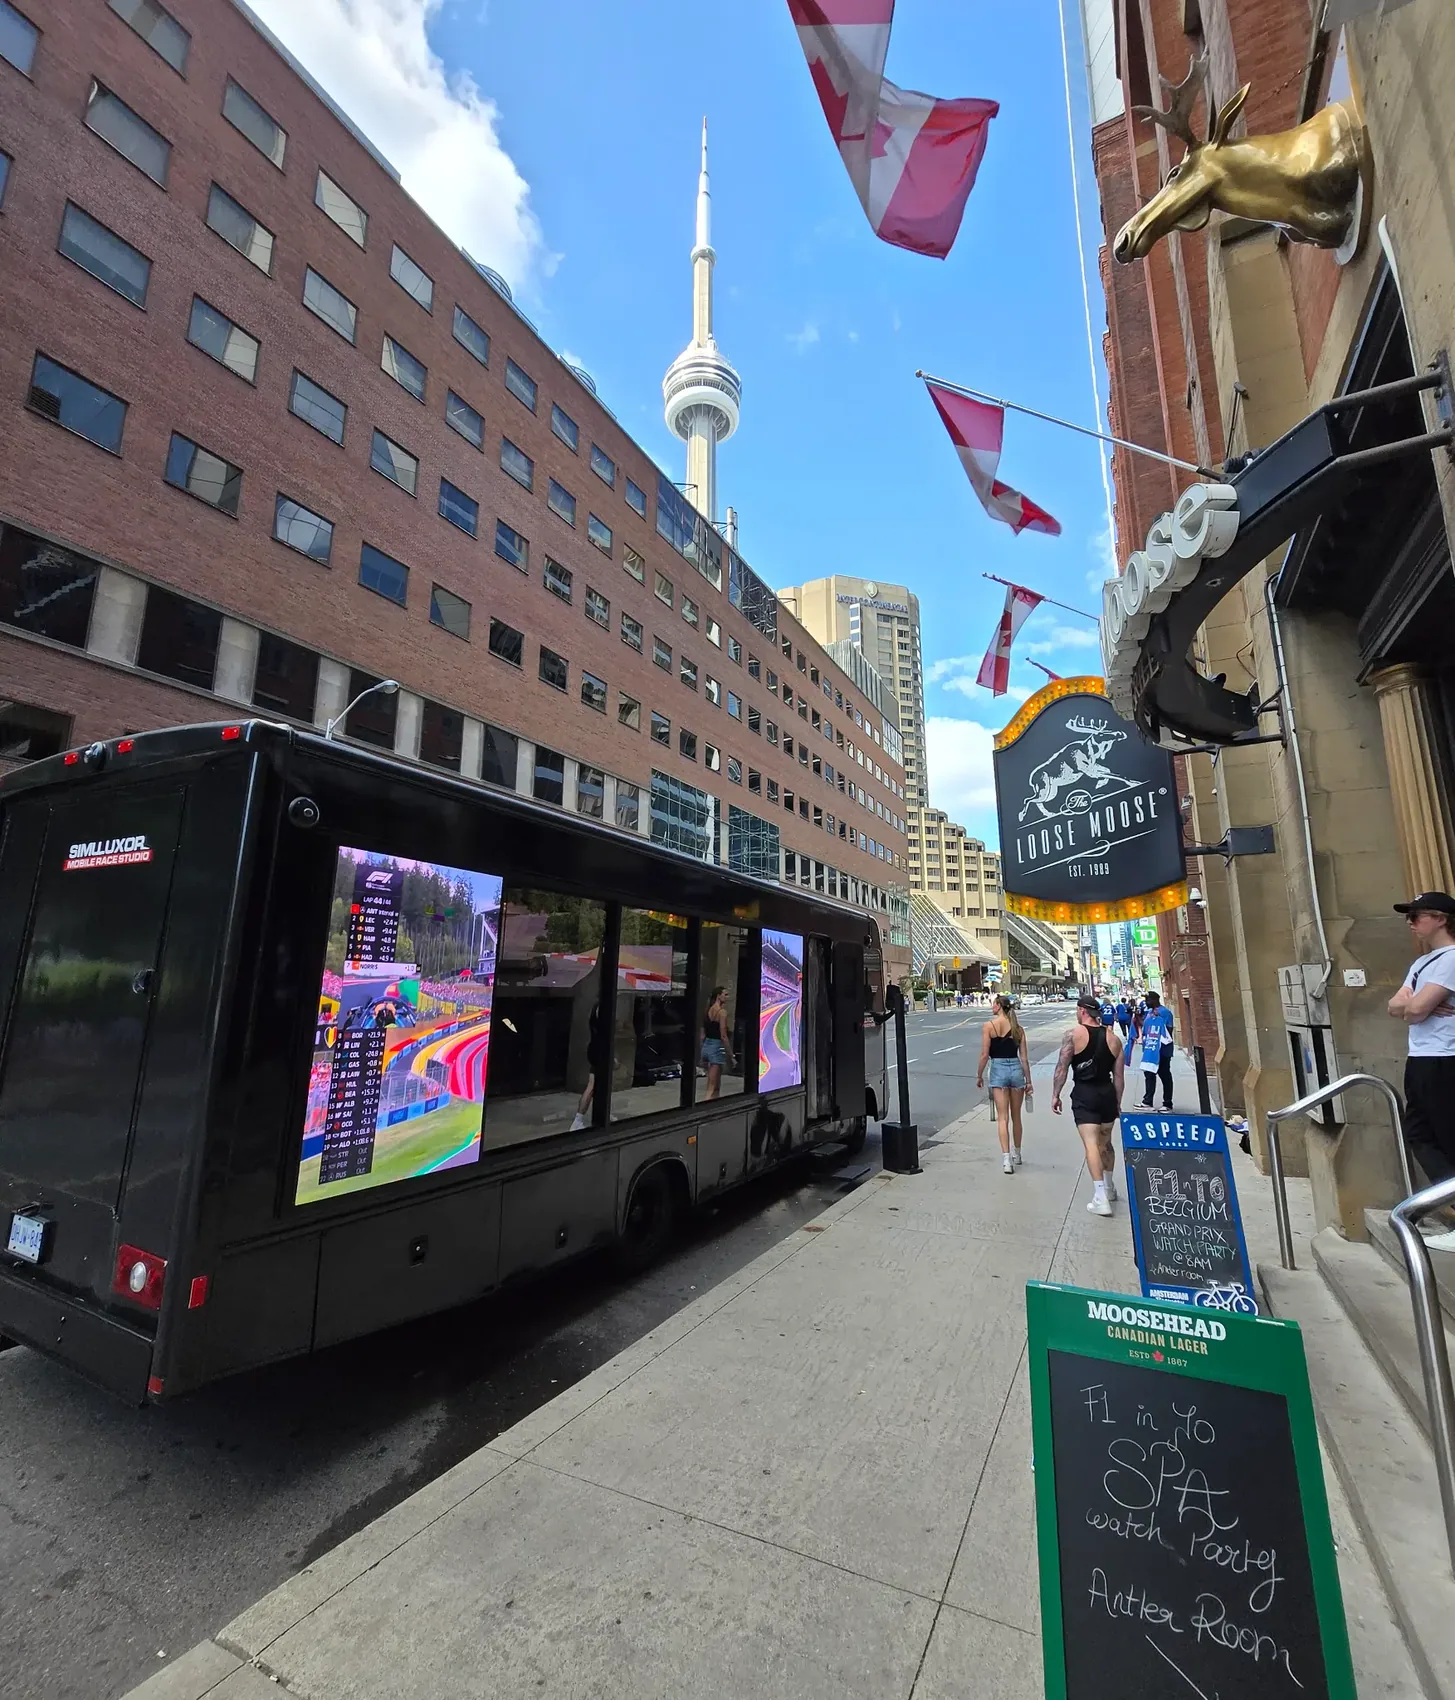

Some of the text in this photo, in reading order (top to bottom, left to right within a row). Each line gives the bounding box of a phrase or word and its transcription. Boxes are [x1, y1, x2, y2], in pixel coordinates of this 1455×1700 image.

[1068, 793, 1088, 809] The
[1016, 819, 1076, 864] LOOSE
[66, 851, 150, 869] MOBILE RACE STUDIO
[1068, 862, 1110, 878] EST. 1989
[1136, 929, 1156, 941] TD
[340, 1130, 352, 1138] BOT
[338, 1140, 351, 1149] ALO
[337, 1151, 349, 1159] STR
[336, 1161, 348, 1169] PER
[335, 1171, 347, 1179] RUS
[1147, 1167, 1187, 1201] F1
[1190, 1173, 1225, 1203] TO
[1144, 1196, 1229, 1221] BELGIUM
[1149, 1219, 1227, 1244] GRAND PRIX
[1152, 1234, 1237, 1261] WATCH PARTY
[1149, 1288, 1189, 1301] AMSTERDAM
[1087, 1300, 1227, 1341] MOOSEHEAD
[1107, 1325, 1209, 1355] CANADIAN LAGER
[1166, 1357, 1188, 1367] 1867
[1136, 1404, 1158, 1431] in
[1103, 1438, 1239, 1530] SPA
[1088, 1567, 1304, 1688] Antler Room
